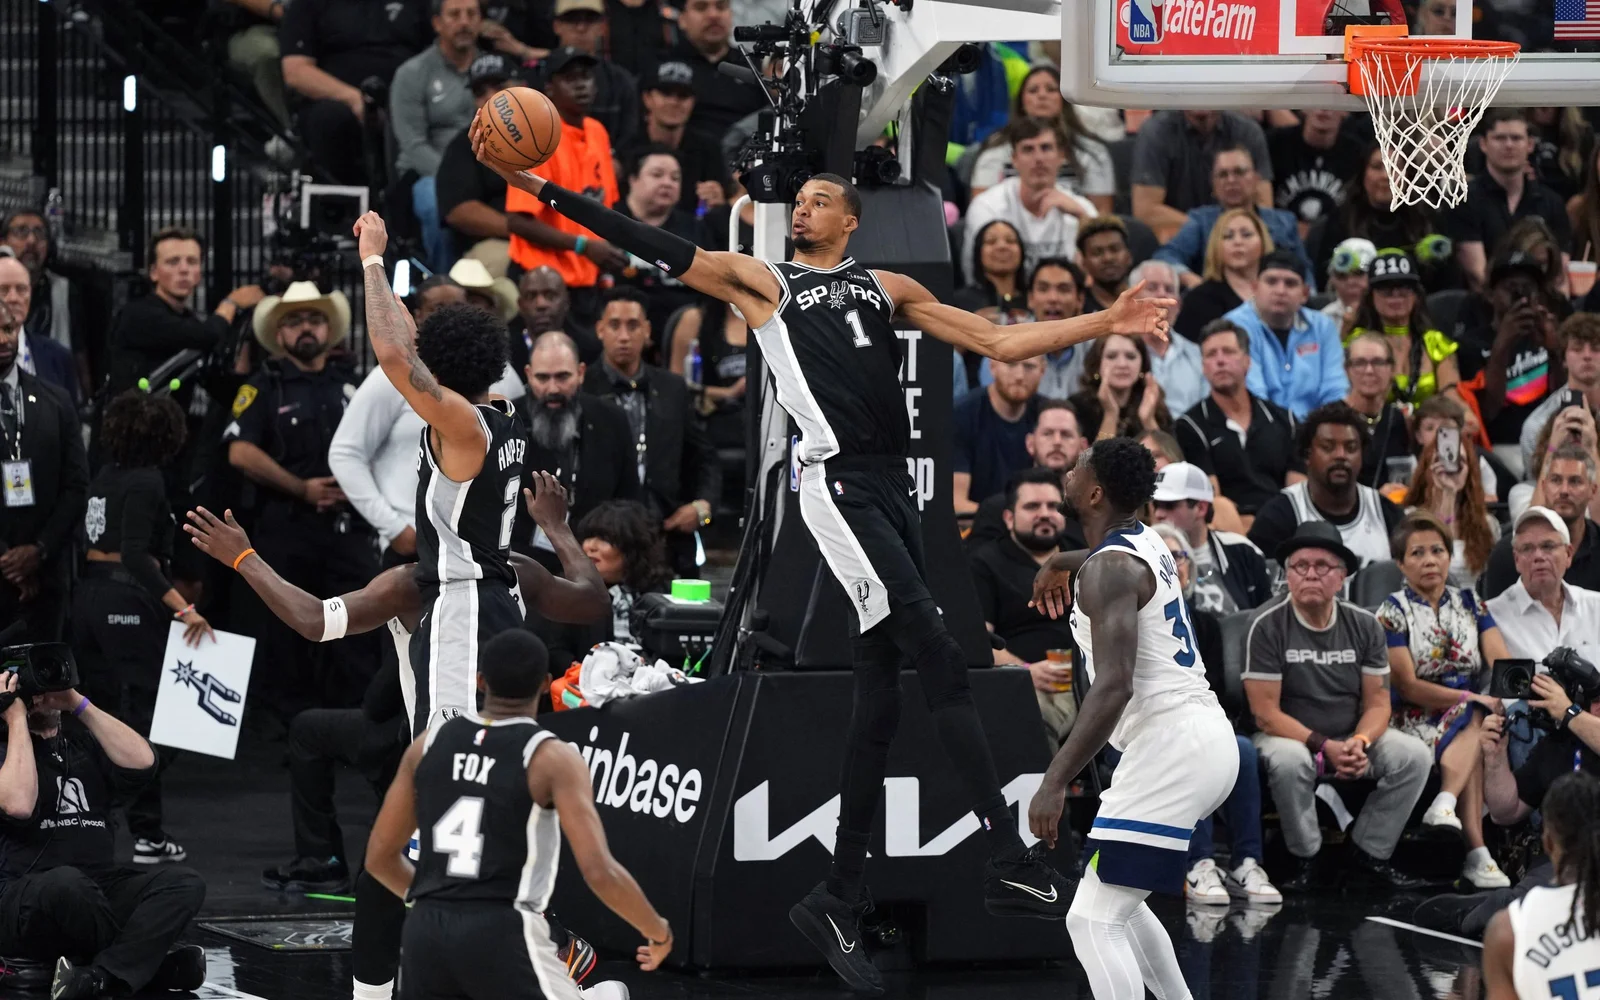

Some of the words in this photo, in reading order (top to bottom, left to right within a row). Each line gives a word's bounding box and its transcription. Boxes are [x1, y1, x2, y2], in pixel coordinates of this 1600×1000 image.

[1133, 23, 1151, 38] NBA
[493, 93, 523, 143] Wilson
[1374, 257, 1411, 276] 210
[844, 308, 873, 349] 1
[498, 475, 521, 550] 2
[107, 614, 140, 625] SPURS
[1164, 597, 1201, 668] 3
[1285, 648, 1357, 665] SPURS
[452, 752, 496, 785] FOX
[567, 725, 703, 823] inbase
[57, 818, 79, 827] NBC
[432, 796, 485, 879] 4
